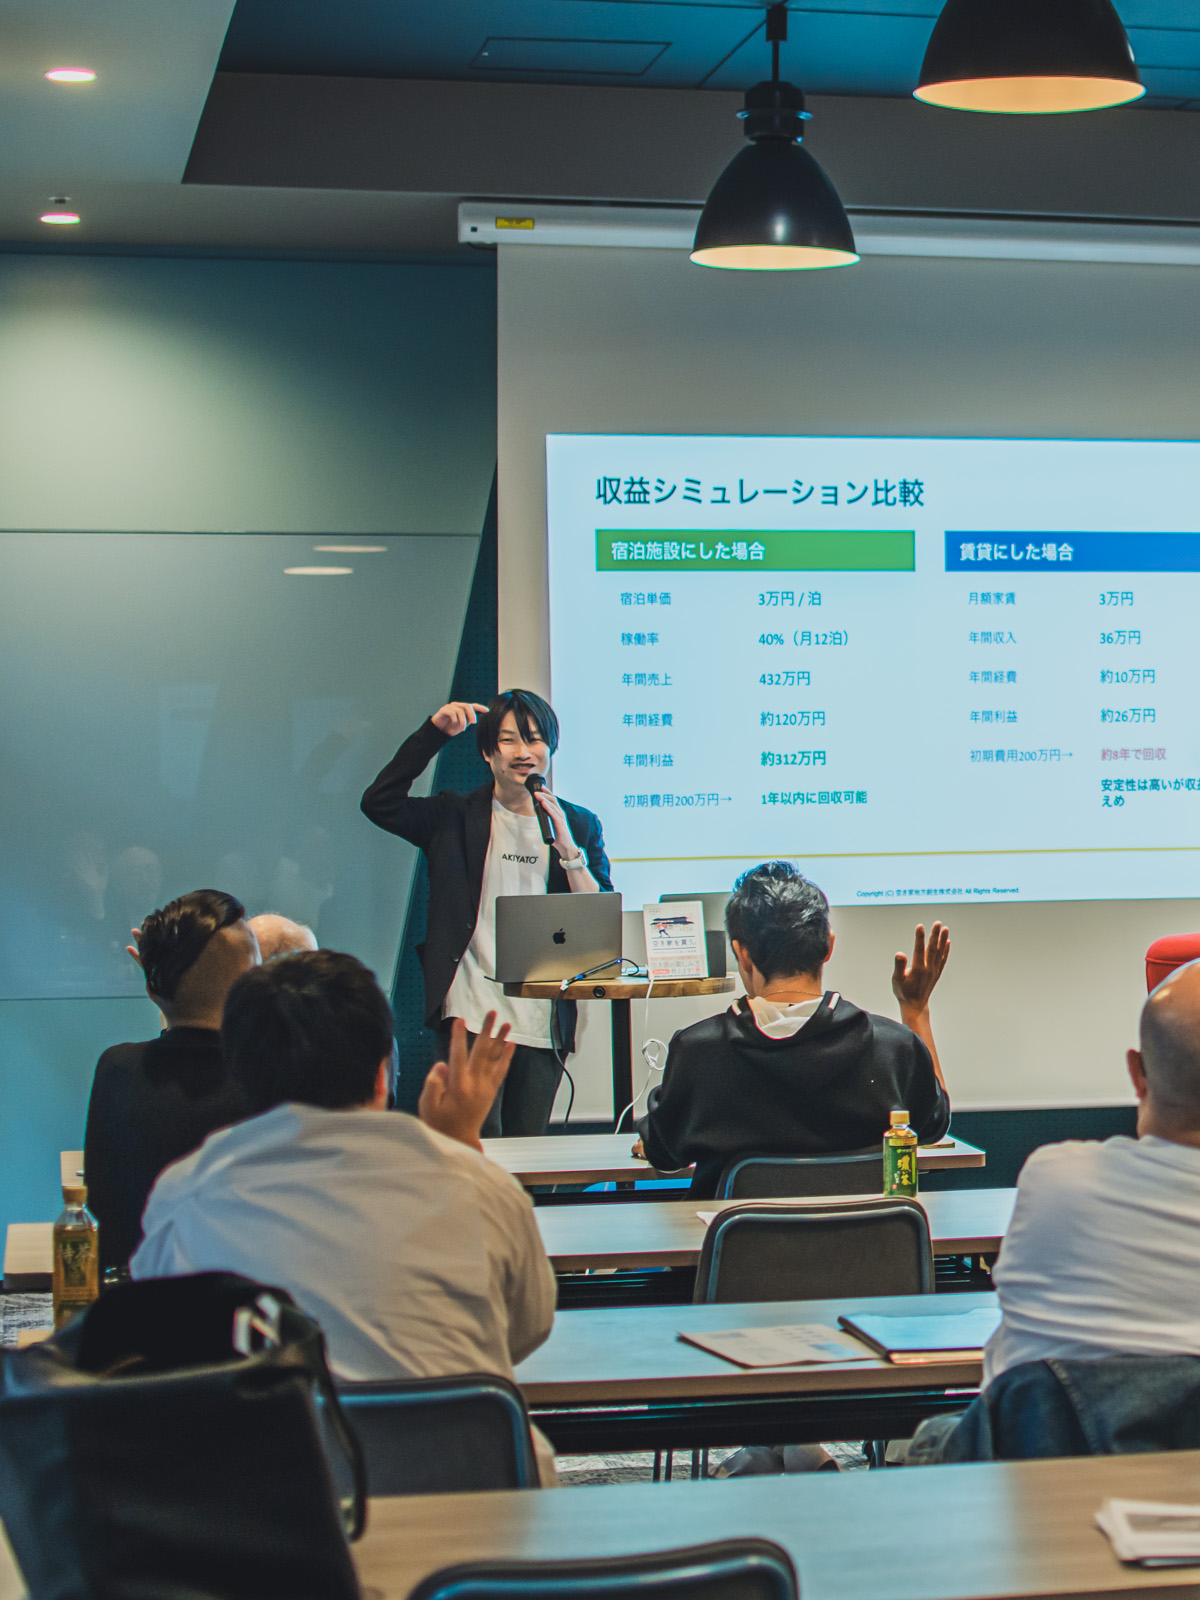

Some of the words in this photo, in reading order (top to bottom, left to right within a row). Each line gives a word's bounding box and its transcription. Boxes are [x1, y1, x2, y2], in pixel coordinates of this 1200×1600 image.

[595, 475, 925, 508] 収益シミュレーション比較
[610, 541, 766, 562] 宿泊施設にした場合
[959, 542, 1075, 562] 賃貸にした場合
[620, 592, 672, 606] 宿泊単価
[758, 591, 795, 607] 3万円
[807, 591, 822, 607] 泊
[968, 592, 1016, 606] 月額家賃
[1098, 591, 1134, 606] 3万円
[620, 632, 659, 646] 稼働率
[968, 631, 1017, 645] 年間収入
[1099, 630, 1141, 645] 36万円
[621, 672, 673, 687] 年間売上
[758, 671, 811, 687] 432万円
[969, 670, 1017, 684] 年間経費
[1100, 668, 1156, 684] 約10万円
[622, 712, 673, 727] 年間経費
[760, 710, 826, 727] 約120万円
[969, 709, 1018, 724] 年間利益
[1100, 708, 1156, 724] 約26万円
[623, 753, 674, 768] 年間利益
[760, 750, 827, 767] 約312万円
[761, 790, 868, 806] 1年以内に回収可能
[1101, 794, 1125, 808] えめ
[502, 853, 537, 864] AKIYATO
